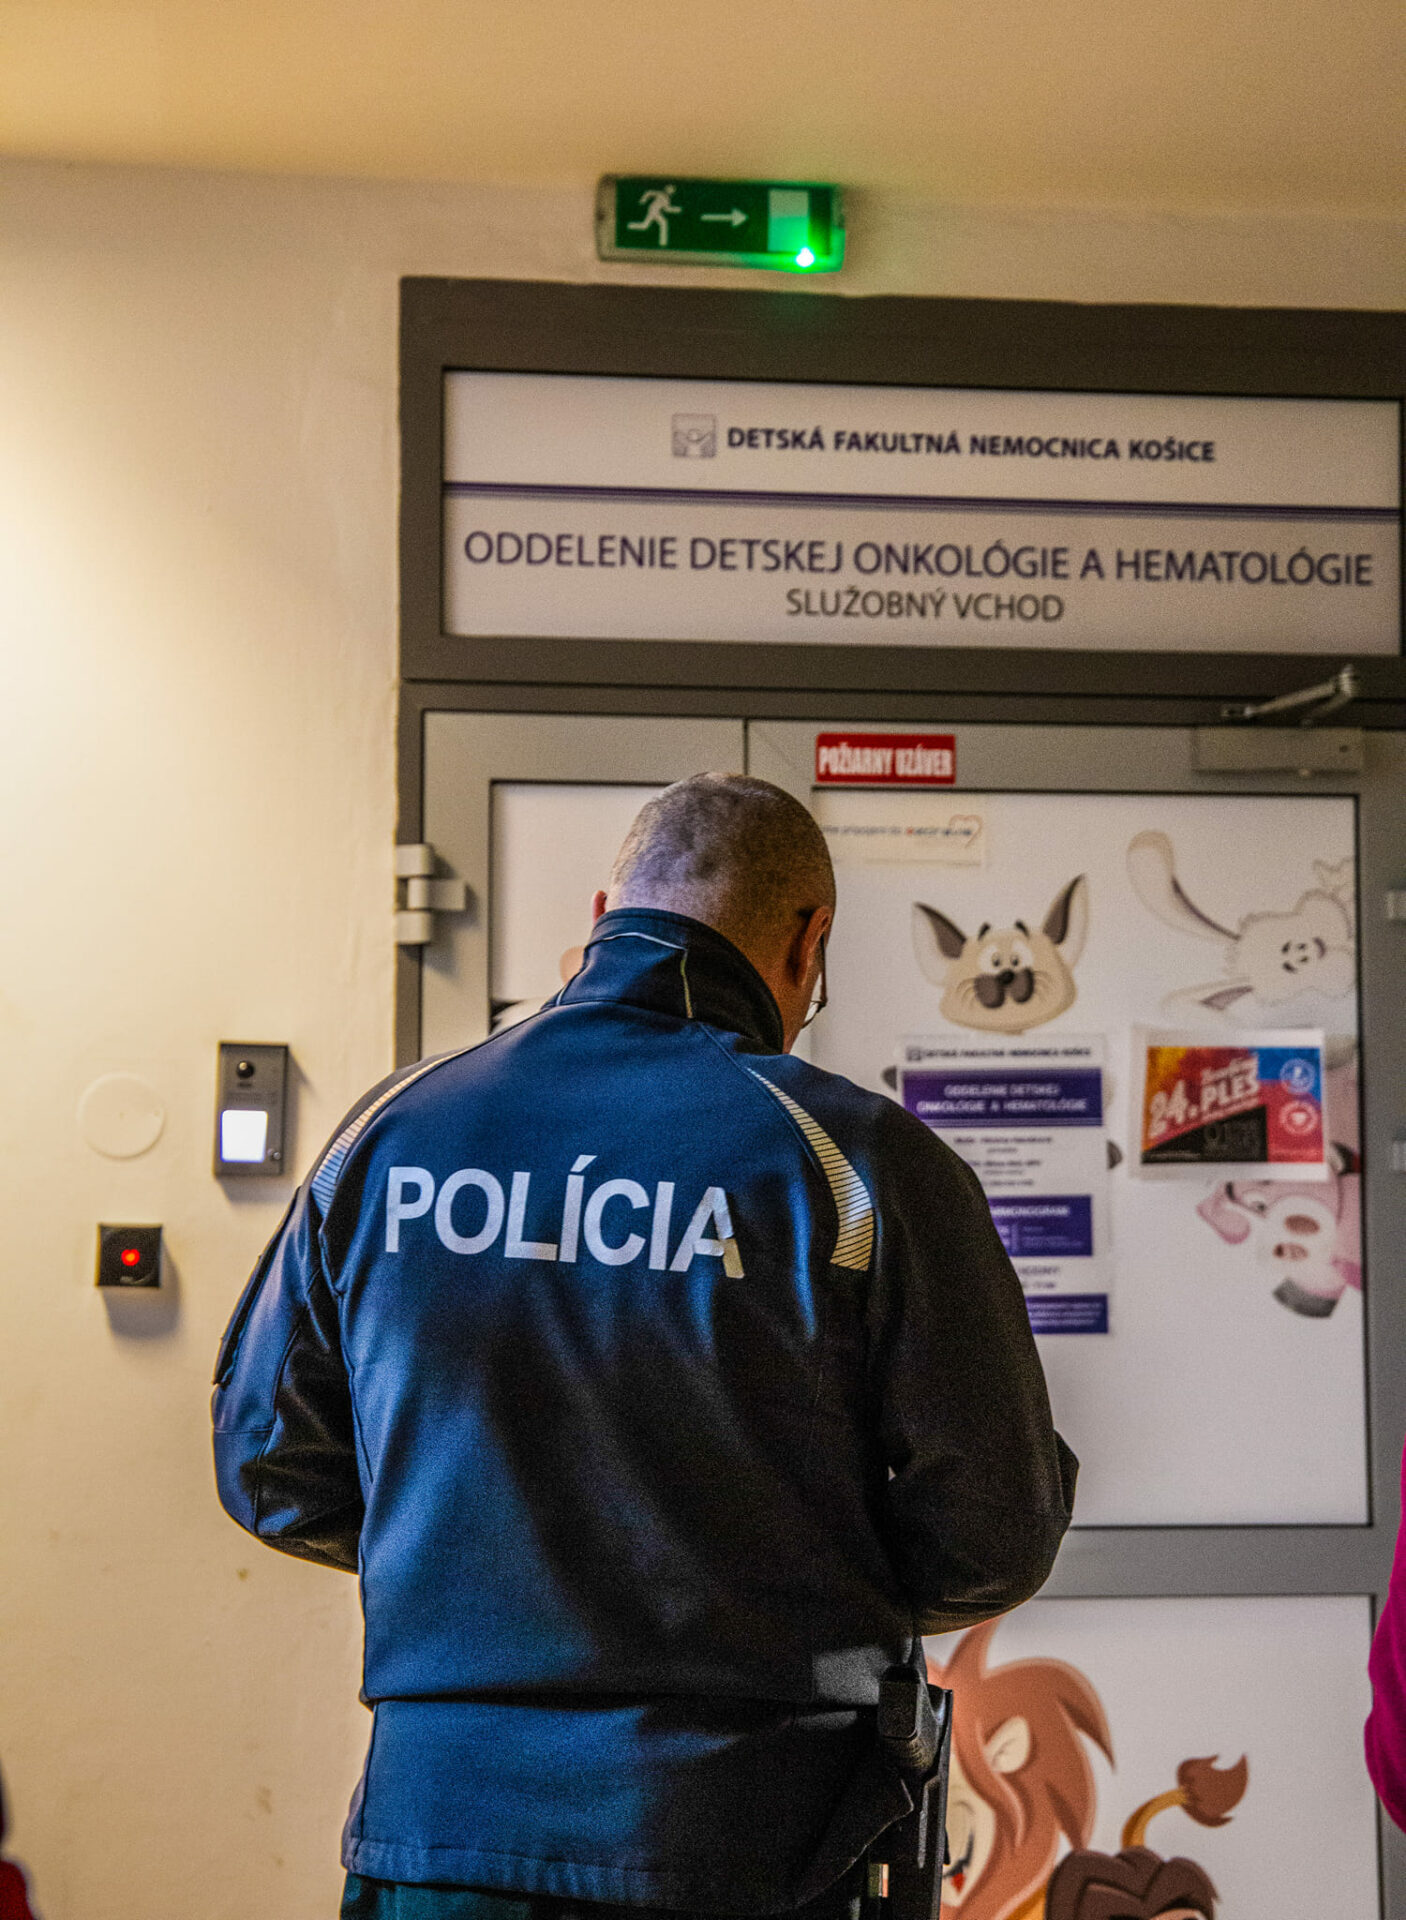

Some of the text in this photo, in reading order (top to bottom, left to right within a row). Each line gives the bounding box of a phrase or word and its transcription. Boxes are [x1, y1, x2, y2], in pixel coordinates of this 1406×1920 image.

[727, 425, 1216, 463] DETSKÁ FAKULTNÁ NEMOCNICA KOŠICE
[464, 530, 1374, 587] ODDELENIE DETSKEJ ONKOLÓGIE A HEMATOLÓGIE
[786, 584, 1065, 622] SLUŽOBNÝ VCHOD
[385, 1154, 745, 1279] POLÍCIA
